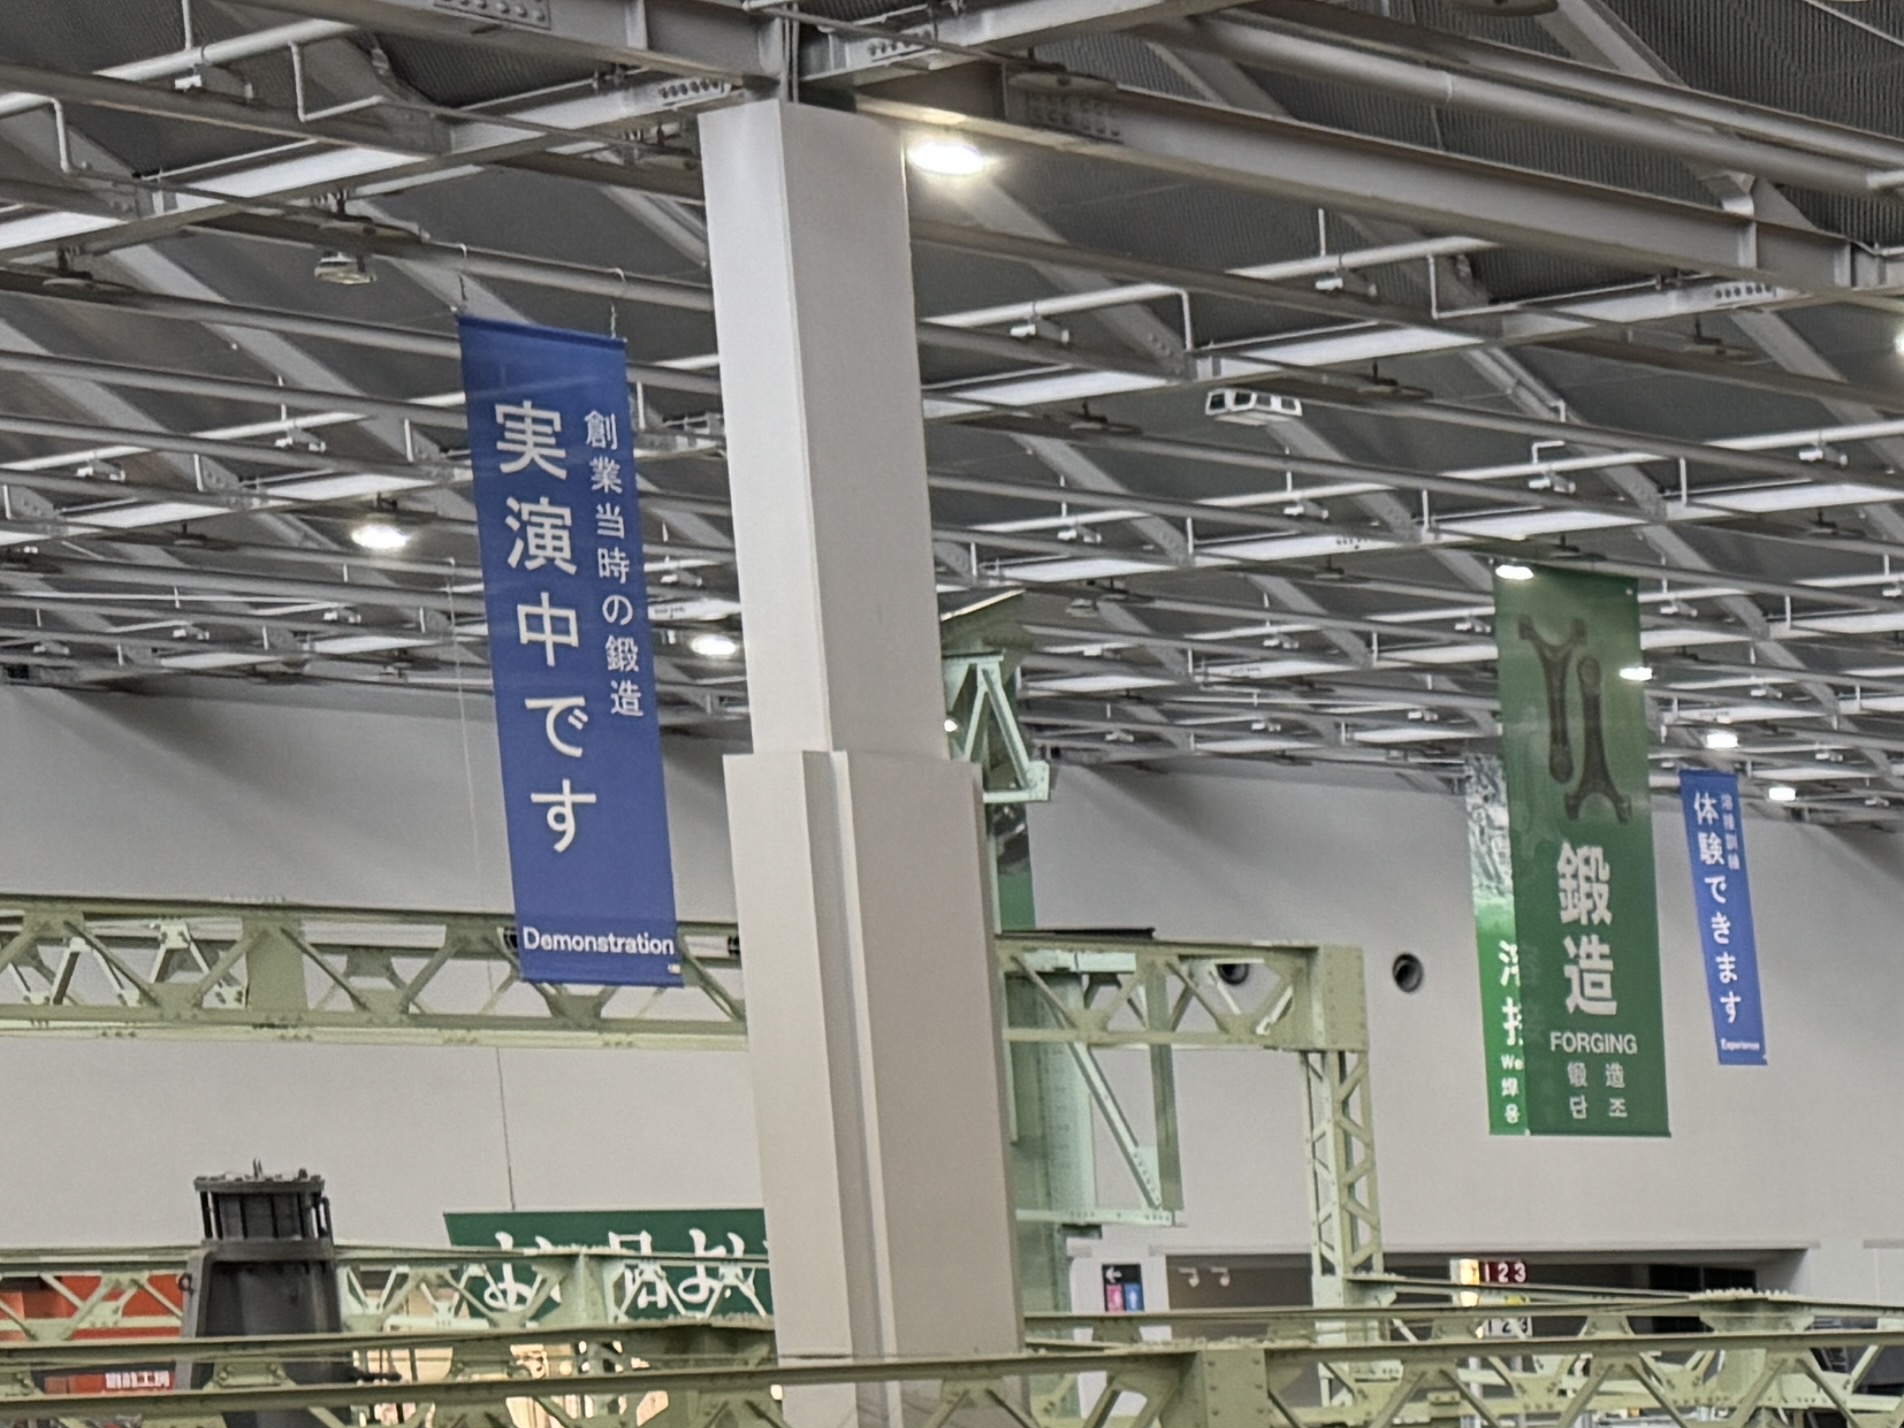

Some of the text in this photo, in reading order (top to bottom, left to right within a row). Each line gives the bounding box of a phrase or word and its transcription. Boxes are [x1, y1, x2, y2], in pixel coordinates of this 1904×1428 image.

[494, 399, 597, 853] 実演中です
[583, 409, 644, 718] 創業当時の鍛造
[522, 927, 676, 957] Demonstration
[1556, 841, 1618, 1016] 鍛造
[1693, 790, 1742, 1024] 体験できます
[1550, 1031, 1638, 1055] FORGING
